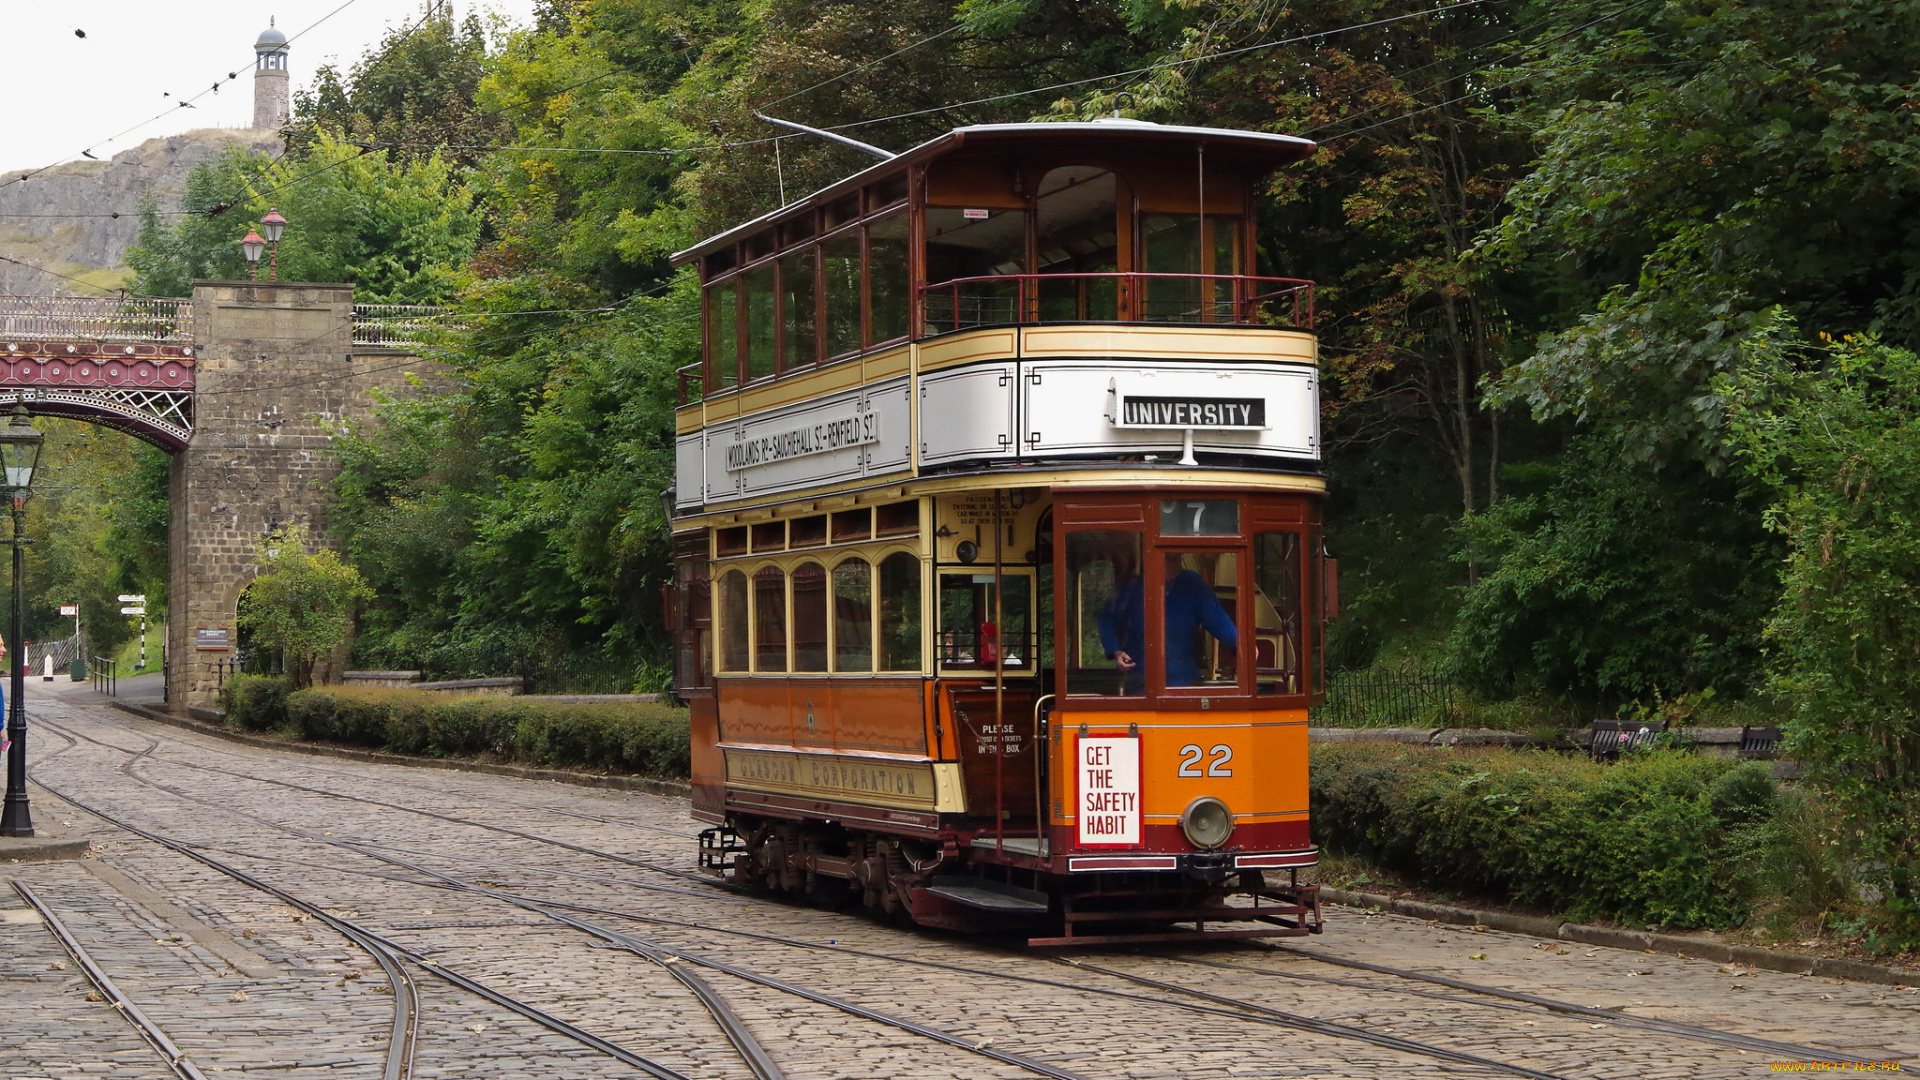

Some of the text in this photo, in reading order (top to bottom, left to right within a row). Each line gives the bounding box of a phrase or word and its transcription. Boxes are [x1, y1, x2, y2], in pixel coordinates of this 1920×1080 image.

[1124, 402, 1251, 425] UNIVERSITY
[728, 440, 759, 468] WOODLANDS
[1187, 502, 1206, 532] 7
[978, 744, 986, 754] IN
[1006, 744, 1020, 753] BOX
[1086, 746, 1112, 766] GET
[1178, 743, 1233, 778] 22
[740, 757, 915, 795] GLASGOW CORPORATION
[1087, 769, 1113, 789] THE
[1086, 792, 1135, 812] SAFETY
[1087, 815, 1126, 835] HABIT
